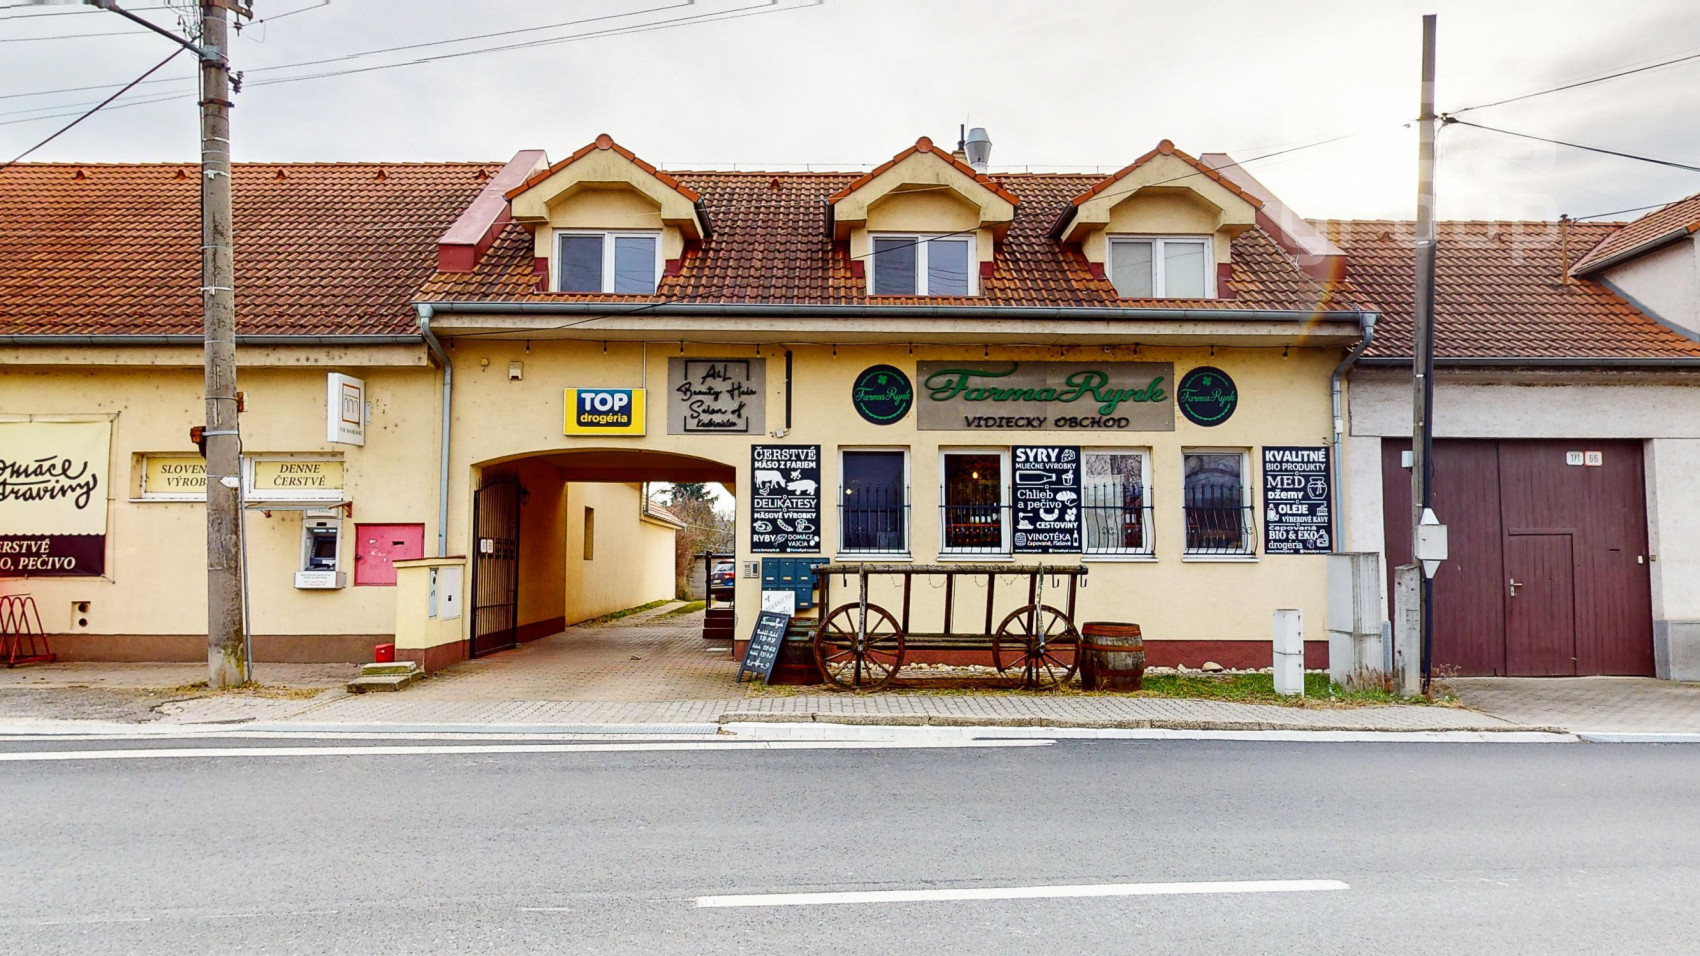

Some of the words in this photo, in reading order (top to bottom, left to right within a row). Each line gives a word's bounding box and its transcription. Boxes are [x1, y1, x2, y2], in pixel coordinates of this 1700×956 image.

[676, 381, 722, 401] Beauty
[726, 381, 757, 400] Hair
[580, 393, 629, 411] TOP
[689, 400, 727, 419] Salon
[580, 412, 628, 424] drogéria
[965, 416, 1047, 428] VIDIECKY
[1054, 416, 1130, 429] OBCHOD
[754, 446, 816, 460] ČERSTVÉ
[1016, 448, 1059, 462] SYRY
[1265, 449, 1326, 462] KVALITNÉ
[280, 464, 320, 474] DENNE
[754, 460, 778, 468] MÄSO
[1265, 463, 1280, 471] BIO
[1282, 463, 1326, 471] PRODUKTY
[273, 474, 326, 486] ČERSTVÉ
[1266, 476, 1305, 488] MED
[1017, 489, 1054, 499] Chlieb
[754, 499, 817, 508] DELIKATESY
[1027, 499, 1062, 510] pečivo
[1278, 505, 1309, 514] OLEJE
[1036, 521, 1078, 529] CESTOVINY
[753, 534, 776, 542] RYBY
[1027, 532, 1071, 541] VINOTÉKA
[1268, 531, 1286, 539] BIO
[1288, 531, 1296, 539] &
[1298, 531, 1317, 540] EKO
[0, 539, 51, 553] RSTVÉ
[1268, 541, 1303, 550] drogéria
[18, 553, 76, 570] PEČIVO
